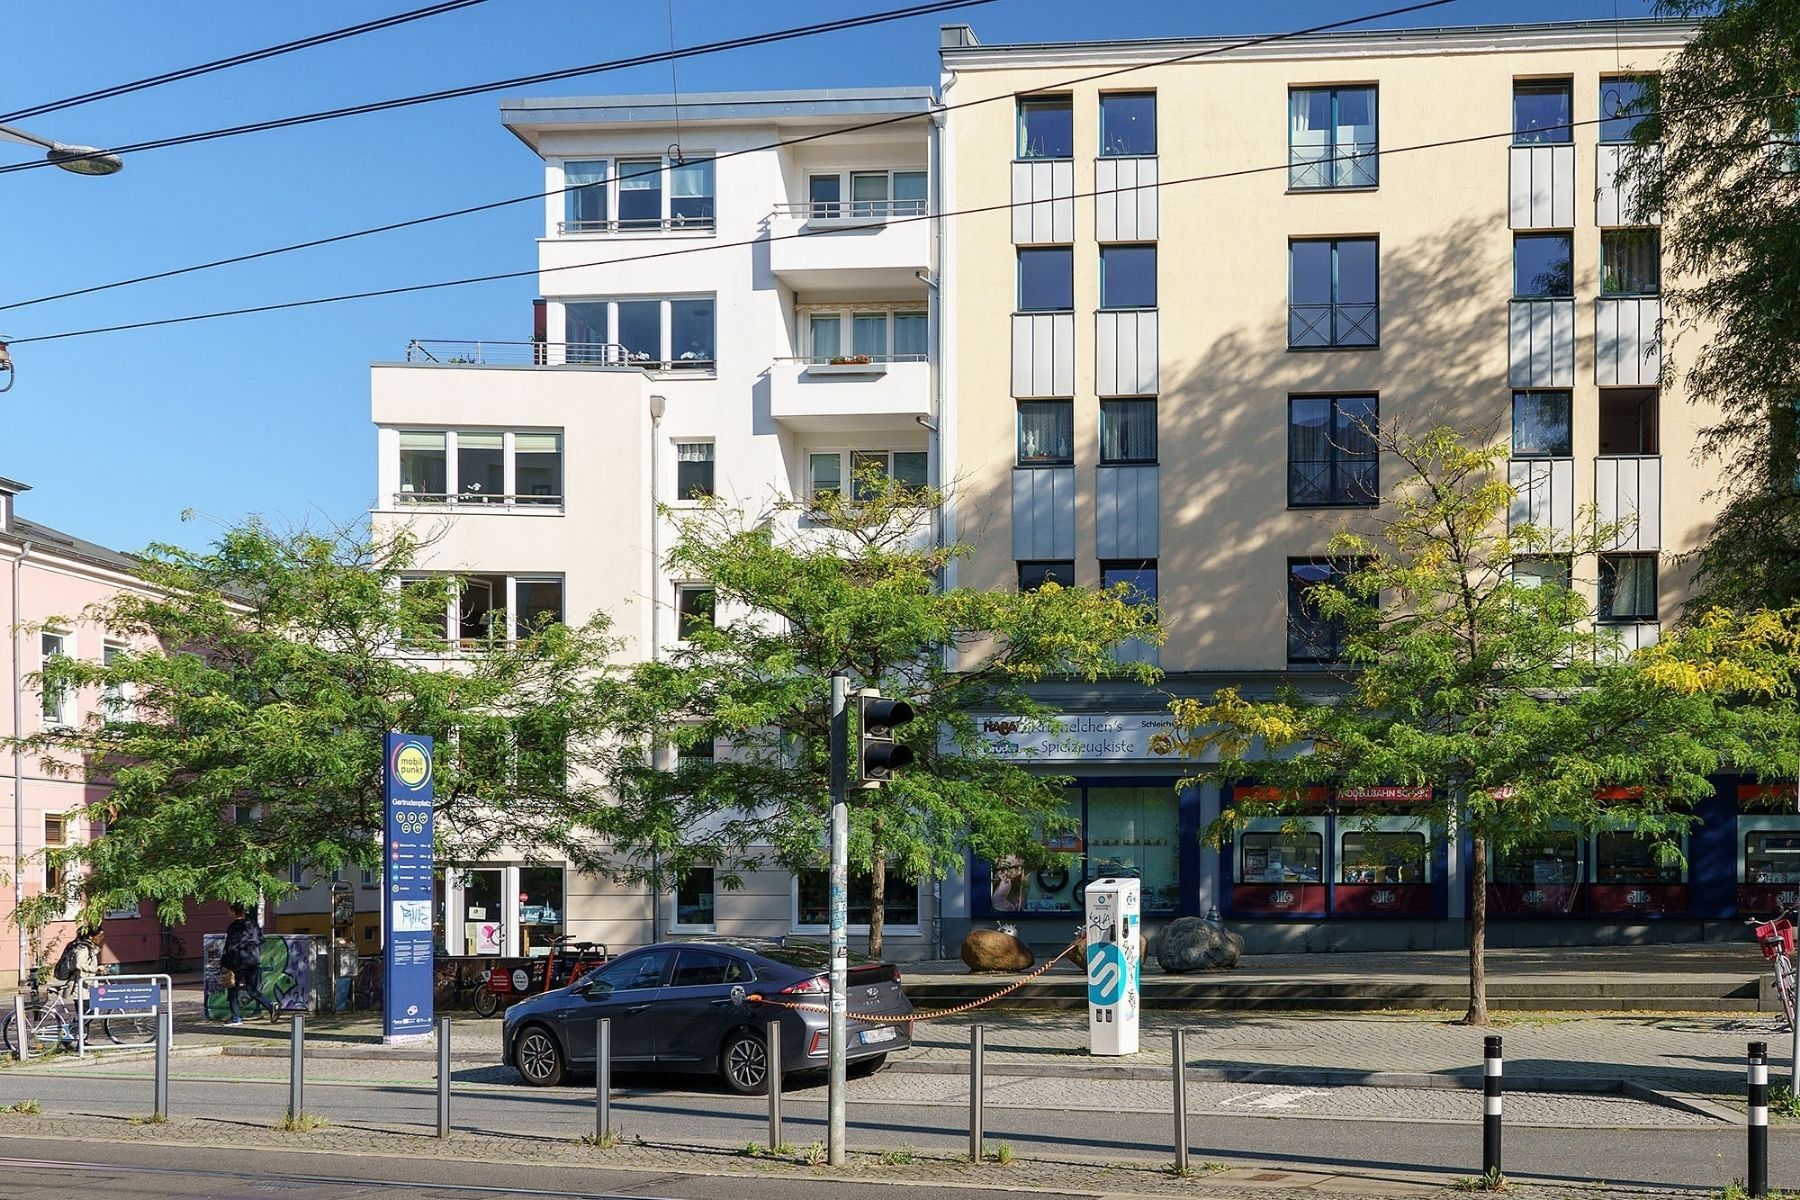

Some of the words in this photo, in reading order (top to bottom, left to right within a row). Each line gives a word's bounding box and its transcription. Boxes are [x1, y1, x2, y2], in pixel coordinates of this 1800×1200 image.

[983, 720, 1018, 736] HABA
[1141, 720, 1172, 728] Schleich
[1041, 739, 1134, 756] Spielzeugkiste
[401, 757, 423, 766] mobil
[401, 766, 423, 775] punkt
[392, 798, 432, 808] Gertrudenplatz
